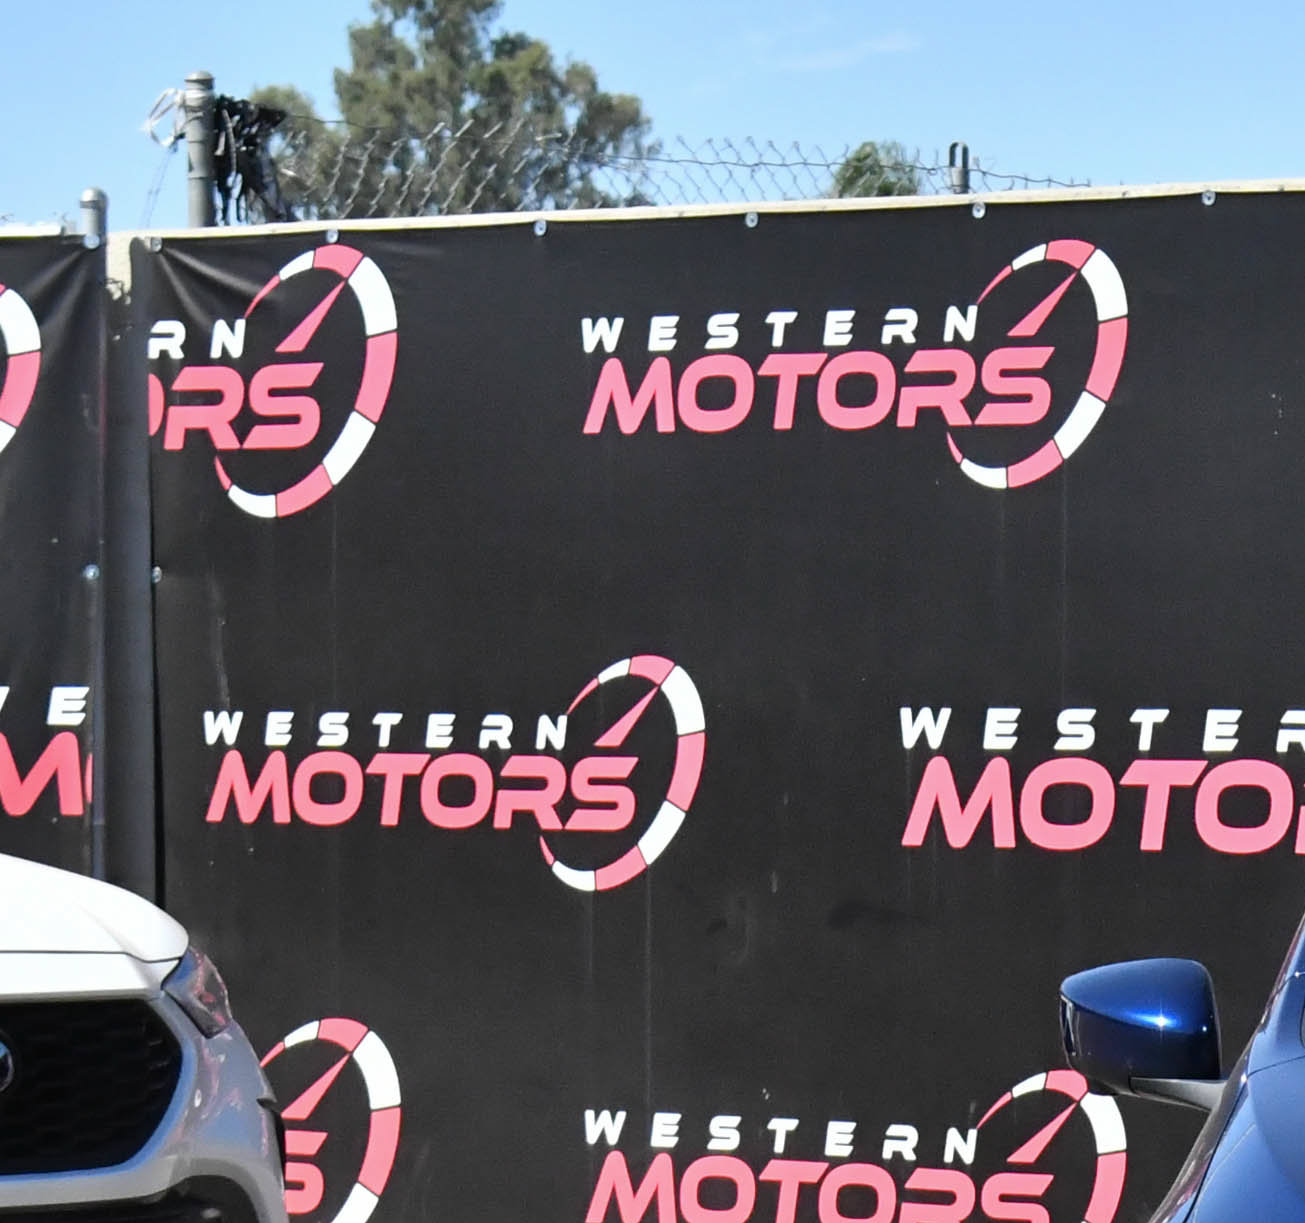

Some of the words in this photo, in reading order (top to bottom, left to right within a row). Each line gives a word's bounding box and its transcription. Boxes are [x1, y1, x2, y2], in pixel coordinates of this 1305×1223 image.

[581, 305, 978, 355] WESTERN
[583, 345, 1055, 435] MOTORS
[204, 711, 568, 750] WESTERN
[206, 750, 639, 832] MOTORS
[584, 1109, 978, 1164] WESTERN
